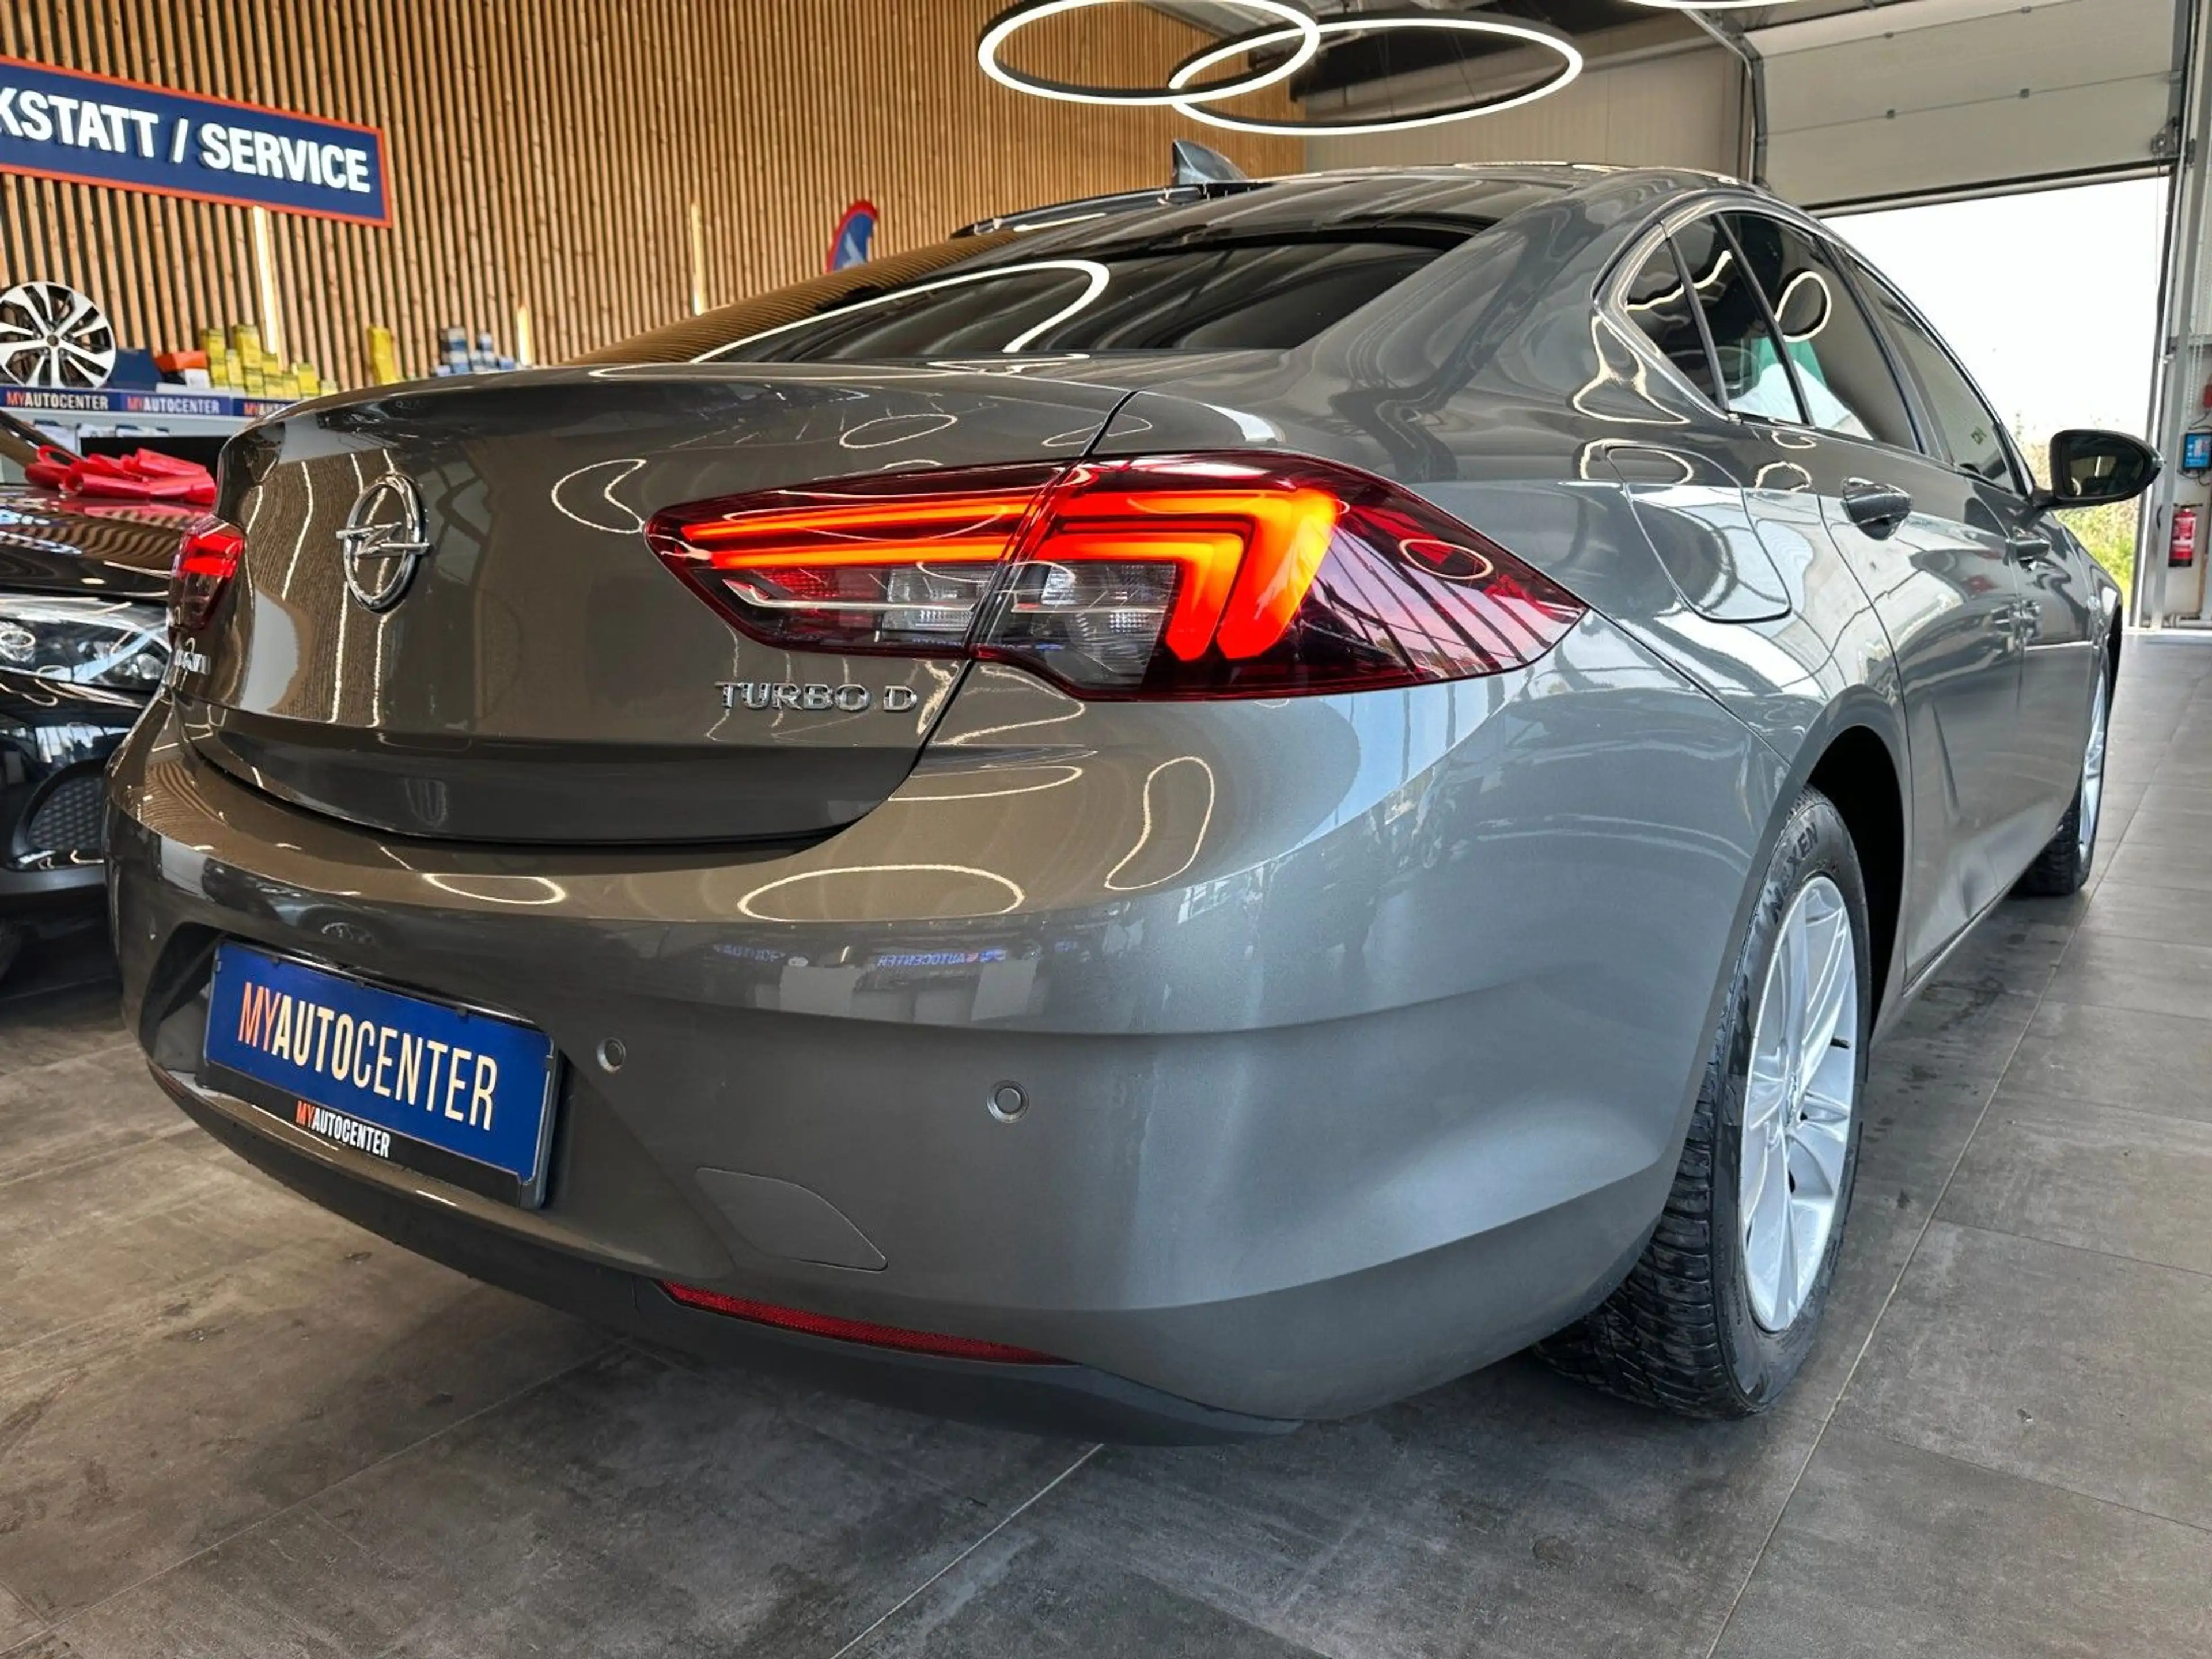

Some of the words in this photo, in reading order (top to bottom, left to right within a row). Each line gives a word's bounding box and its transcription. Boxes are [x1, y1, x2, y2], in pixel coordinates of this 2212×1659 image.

[173, 118, 188, 164] /
[198, 122, 371, 194] SERVICE
[7, 390, 109, 410] MYAUTOCENTER
[127, 396, 220, 414] MYAUTOCENTER
[714, 681, 872, 712] TURBO
[882, 685, 918, 713] D
[237, 982, 498, 1131] MYAUTOCENTER
[294, 1100, 392, 1159] MYAUTOCENTER
